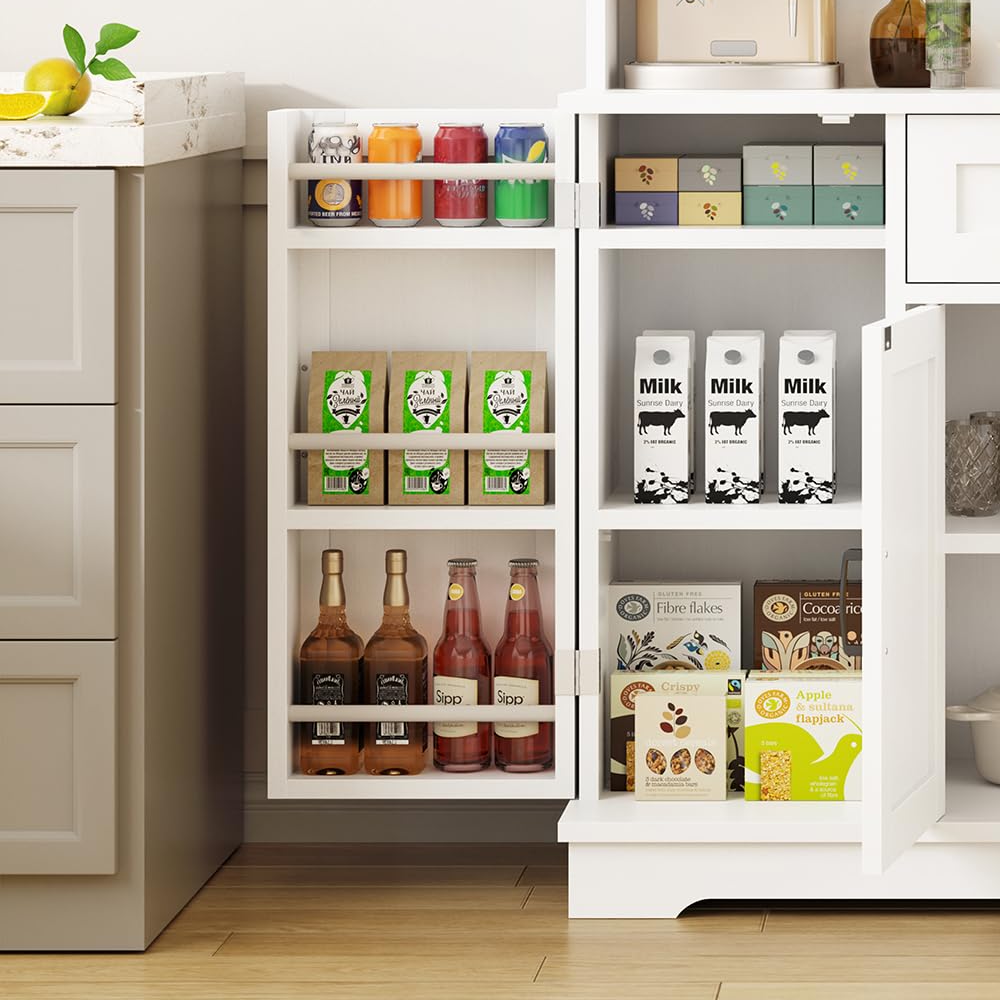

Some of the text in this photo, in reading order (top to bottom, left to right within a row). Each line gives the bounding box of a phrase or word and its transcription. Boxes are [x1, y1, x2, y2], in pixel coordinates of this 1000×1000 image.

[640, 378, 682, 394] Milk
[711, 378, 754, 394] Milk
[784, 378, 827, 394] Milk
[665, 400, 683, 408] Dairy
[736, 400, 754, 408] Dairy
[809, 400, 828, 408] Dairy
[656, 601, 724, 614] Fibre flakes
[802, 602, 863, 615] Cocoa ric
[619, 610, 649, 621] ORGANIC
[766, 610, 795, 620] ORGANIC
[661, 682, 700, 693] Crispy
[436, 689, 462, 705] Sipp
[497, 689, 524, 705] Sipp
[796, 690, 832, 702] Apple
[760, 704, 789, 718] ORGANIC
[796, 702, 854, 712] & sultana
[796, 713, 845, 725] flapjack
